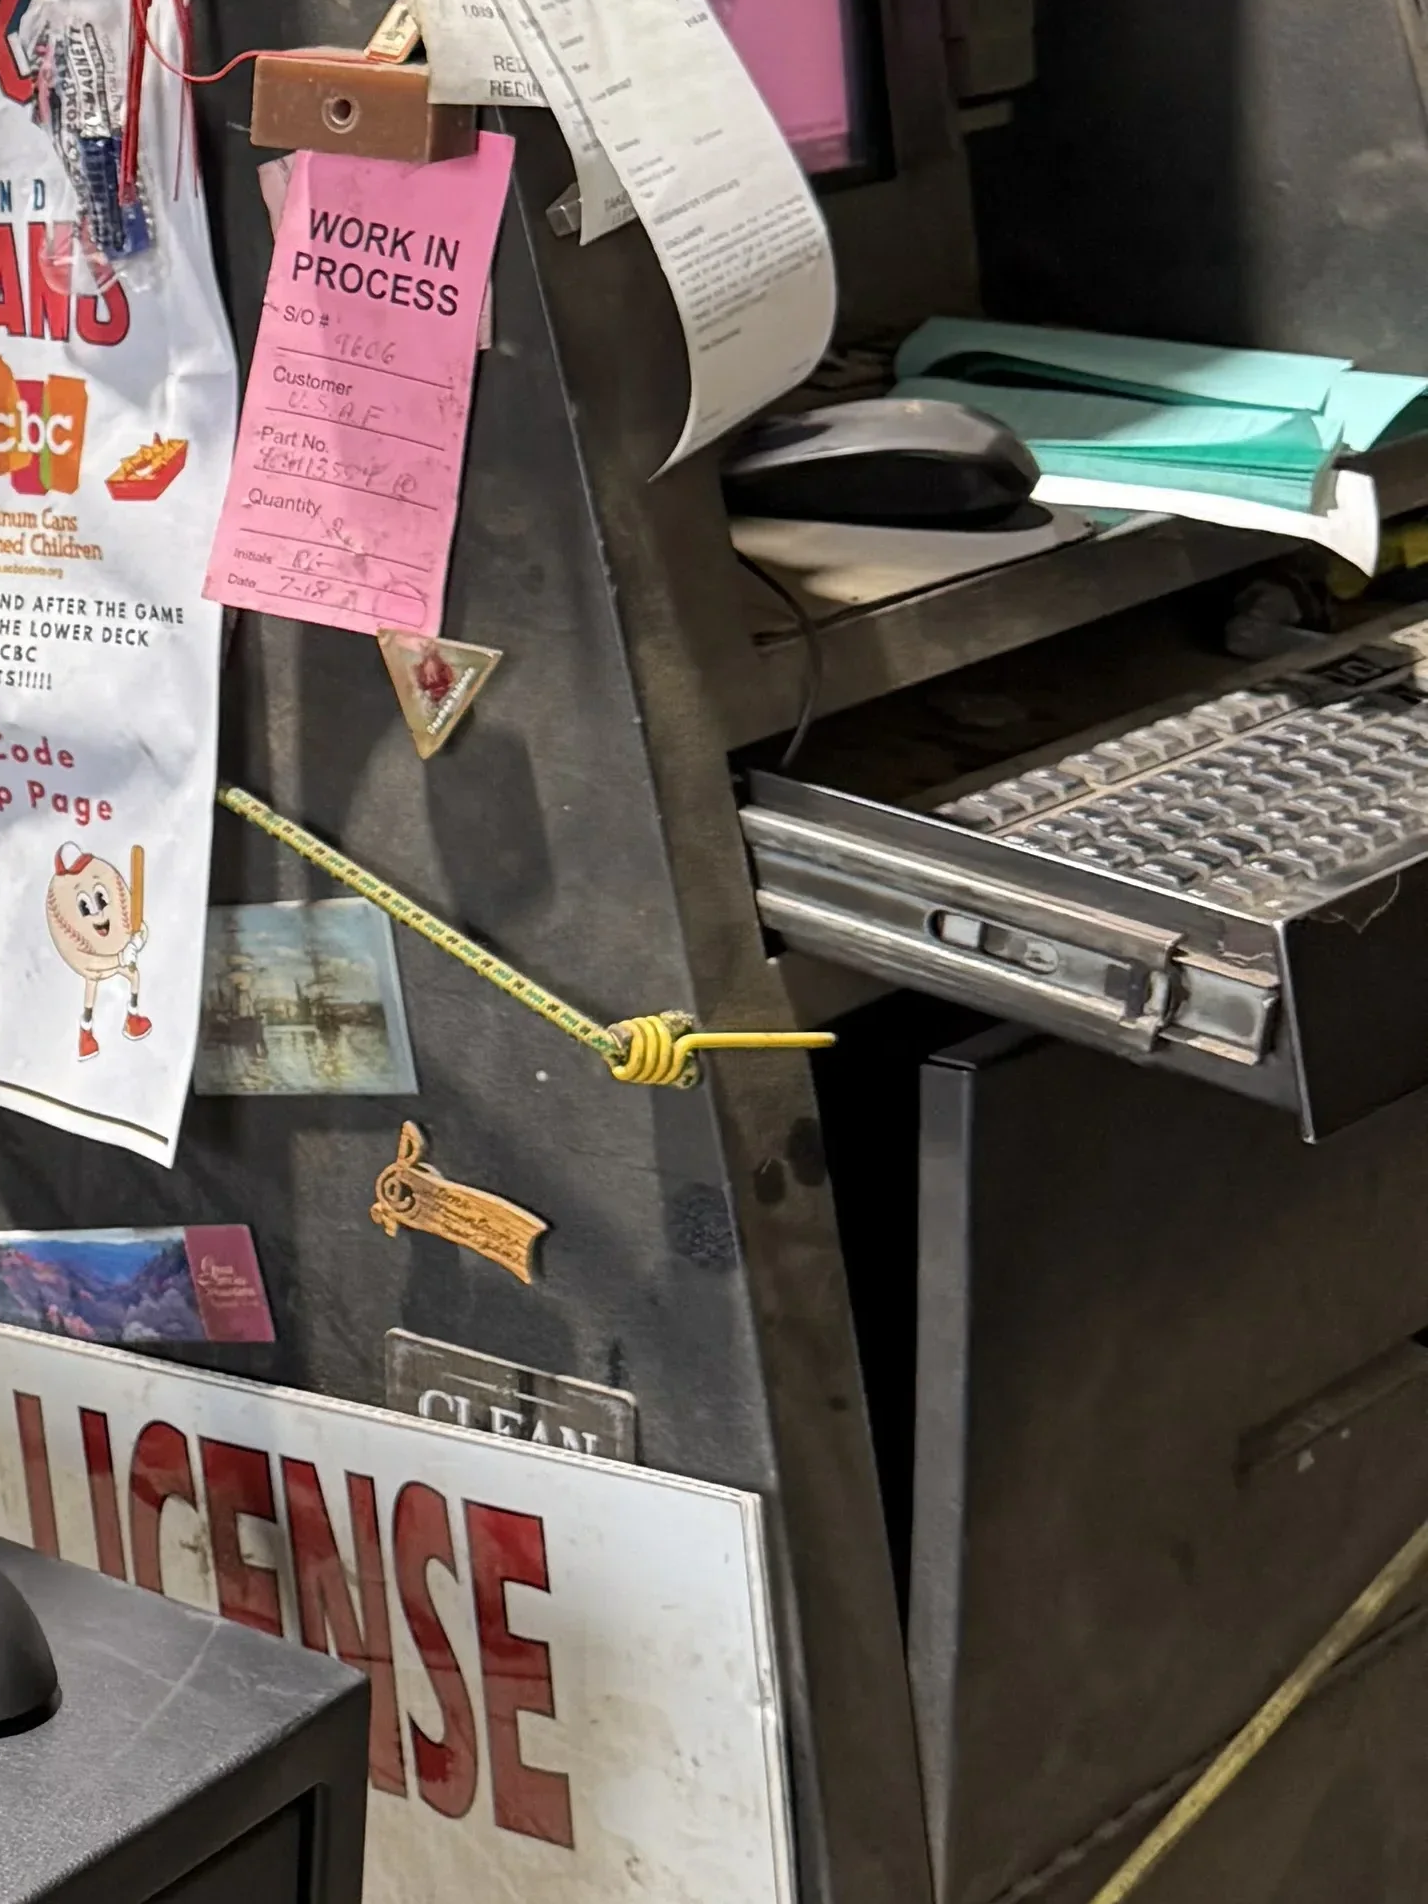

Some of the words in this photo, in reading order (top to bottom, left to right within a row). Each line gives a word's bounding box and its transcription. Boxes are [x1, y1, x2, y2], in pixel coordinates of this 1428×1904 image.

[309, 207, 414, 264] WORK
[423, 232, 461, 273] IN
[292, 250, 461, 317] PROCESS
[283, 303, 316, 329] S/O
[318, 314, 331, 329] #
[272, 364, 354, 398] Customer
[261, 425, 299, 451] Part
[303, 433, 330, 454] No.
[247, 486, 322, 519] Quantity
[42, 507, 78, 532] Cans
[30, 533, 103, 560] Children
[234, 547, 273, 566] Initials
[228, 573, 256, 590] Date
[33, 596, 87, 617] AFTER
[95, 601, 126, 619] THE
[134, 604, 185, 625] GAME
[30, 620, 93, 642] LOWER
[102, 627, 151, 648] DECK
[28, 779, 113, 827] Page
